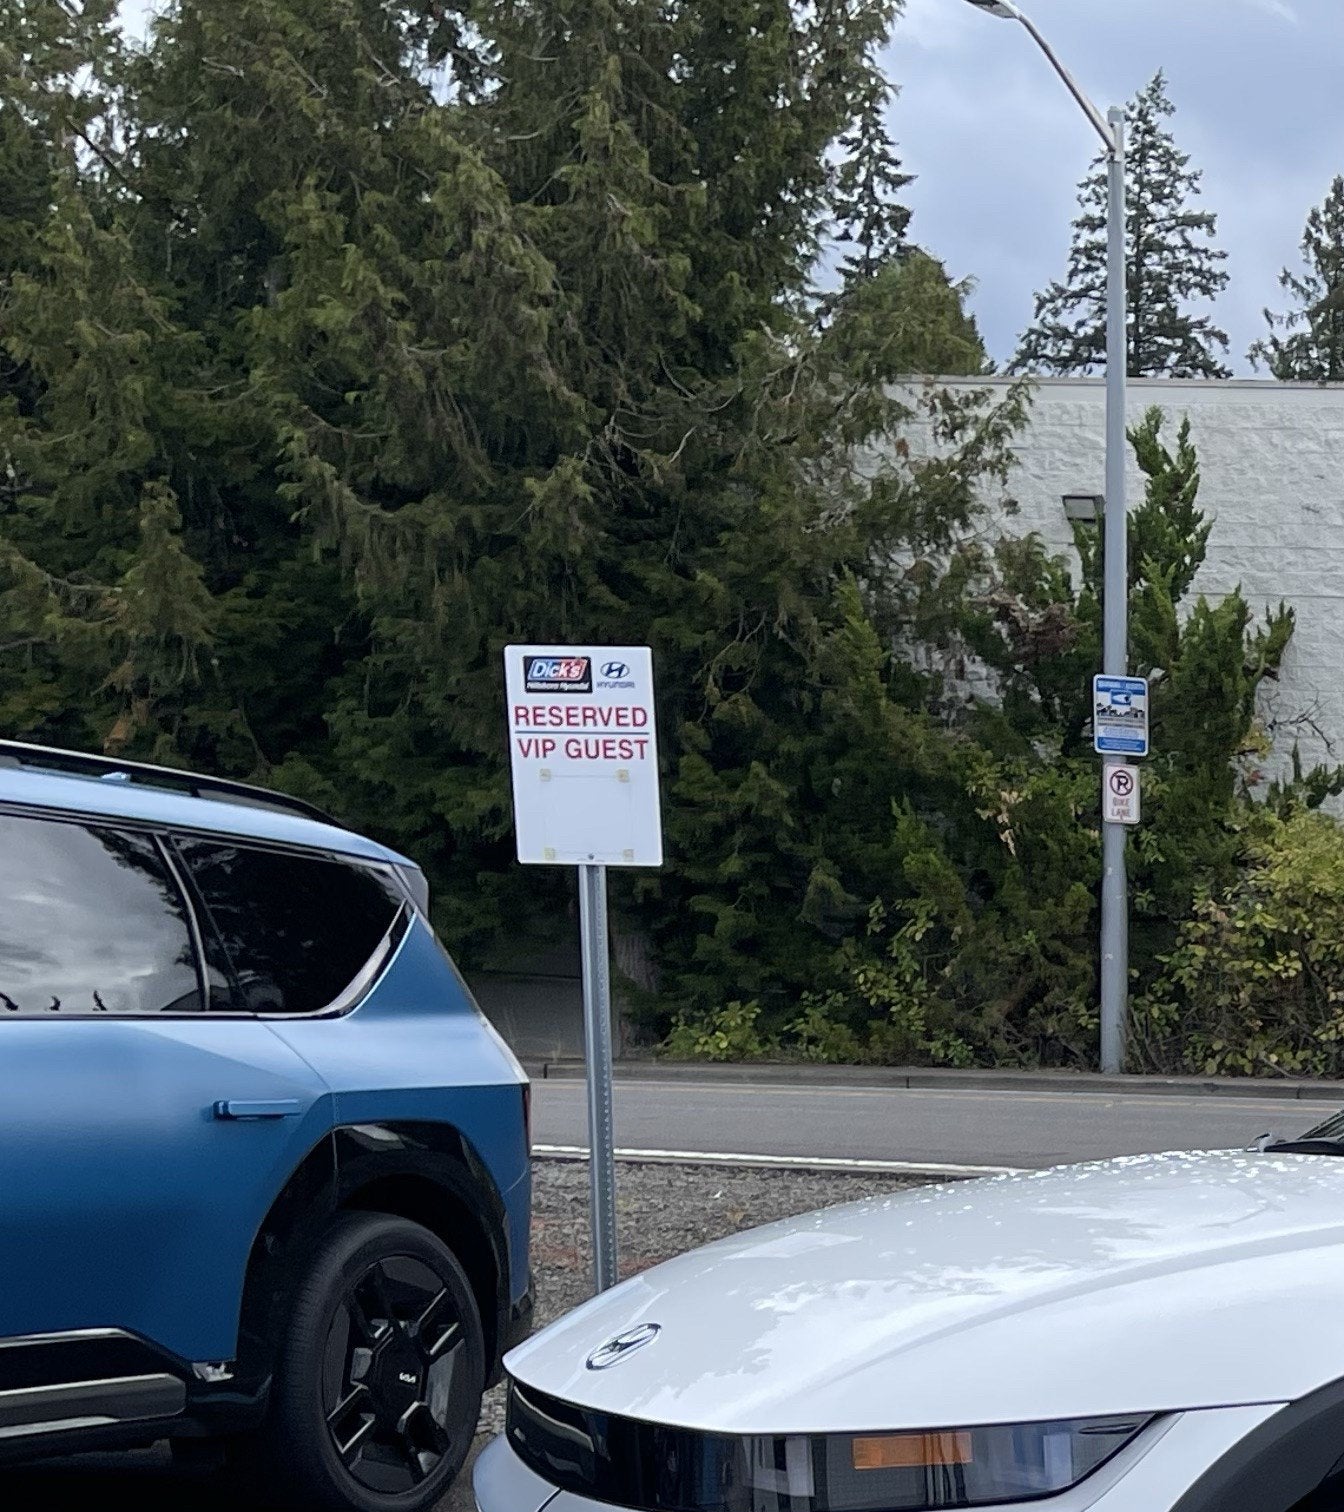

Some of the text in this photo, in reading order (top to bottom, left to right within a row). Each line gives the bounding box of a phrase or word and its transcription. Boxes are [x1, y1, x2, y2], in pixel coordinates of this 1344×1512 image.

[532, 660, 583, 678] Dick's
[514, 705, 648, 728] RESERVED
[517, 738, 649, 760] VIP GUEST
